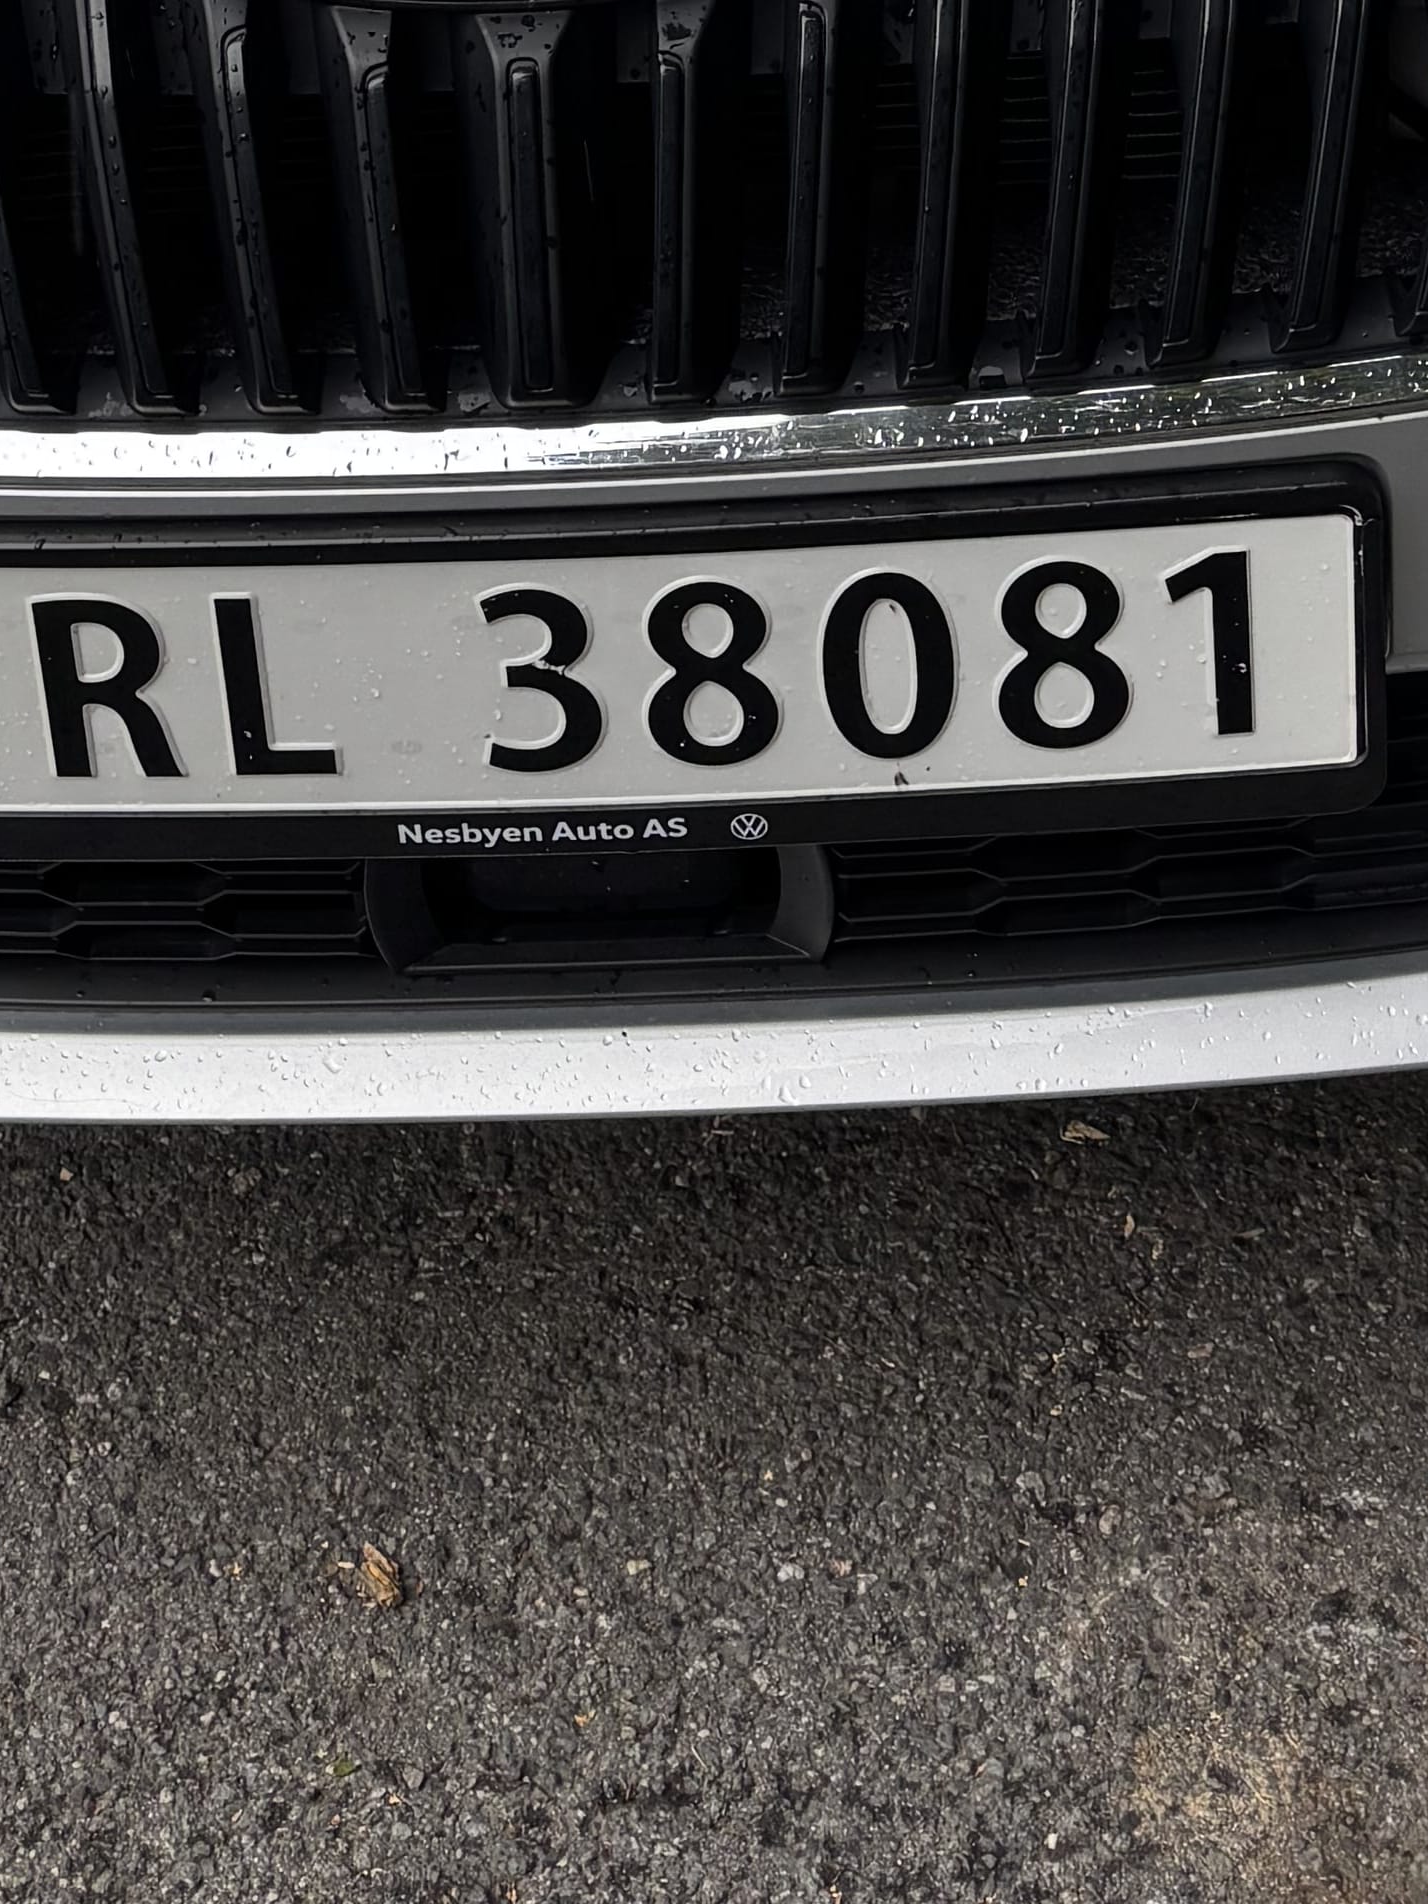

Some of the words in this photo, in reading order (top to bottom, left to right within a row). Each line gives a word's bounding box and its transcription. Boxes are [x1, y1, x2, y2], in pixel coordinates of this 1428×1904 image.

[29, 595, 341, 777] RL
[478, 549, 1255, 773] 38081
[397, 822, 543, 847] Nesbyen
[551, 821, 635, 842] Auto
[643, 817, 688, 838] AS
